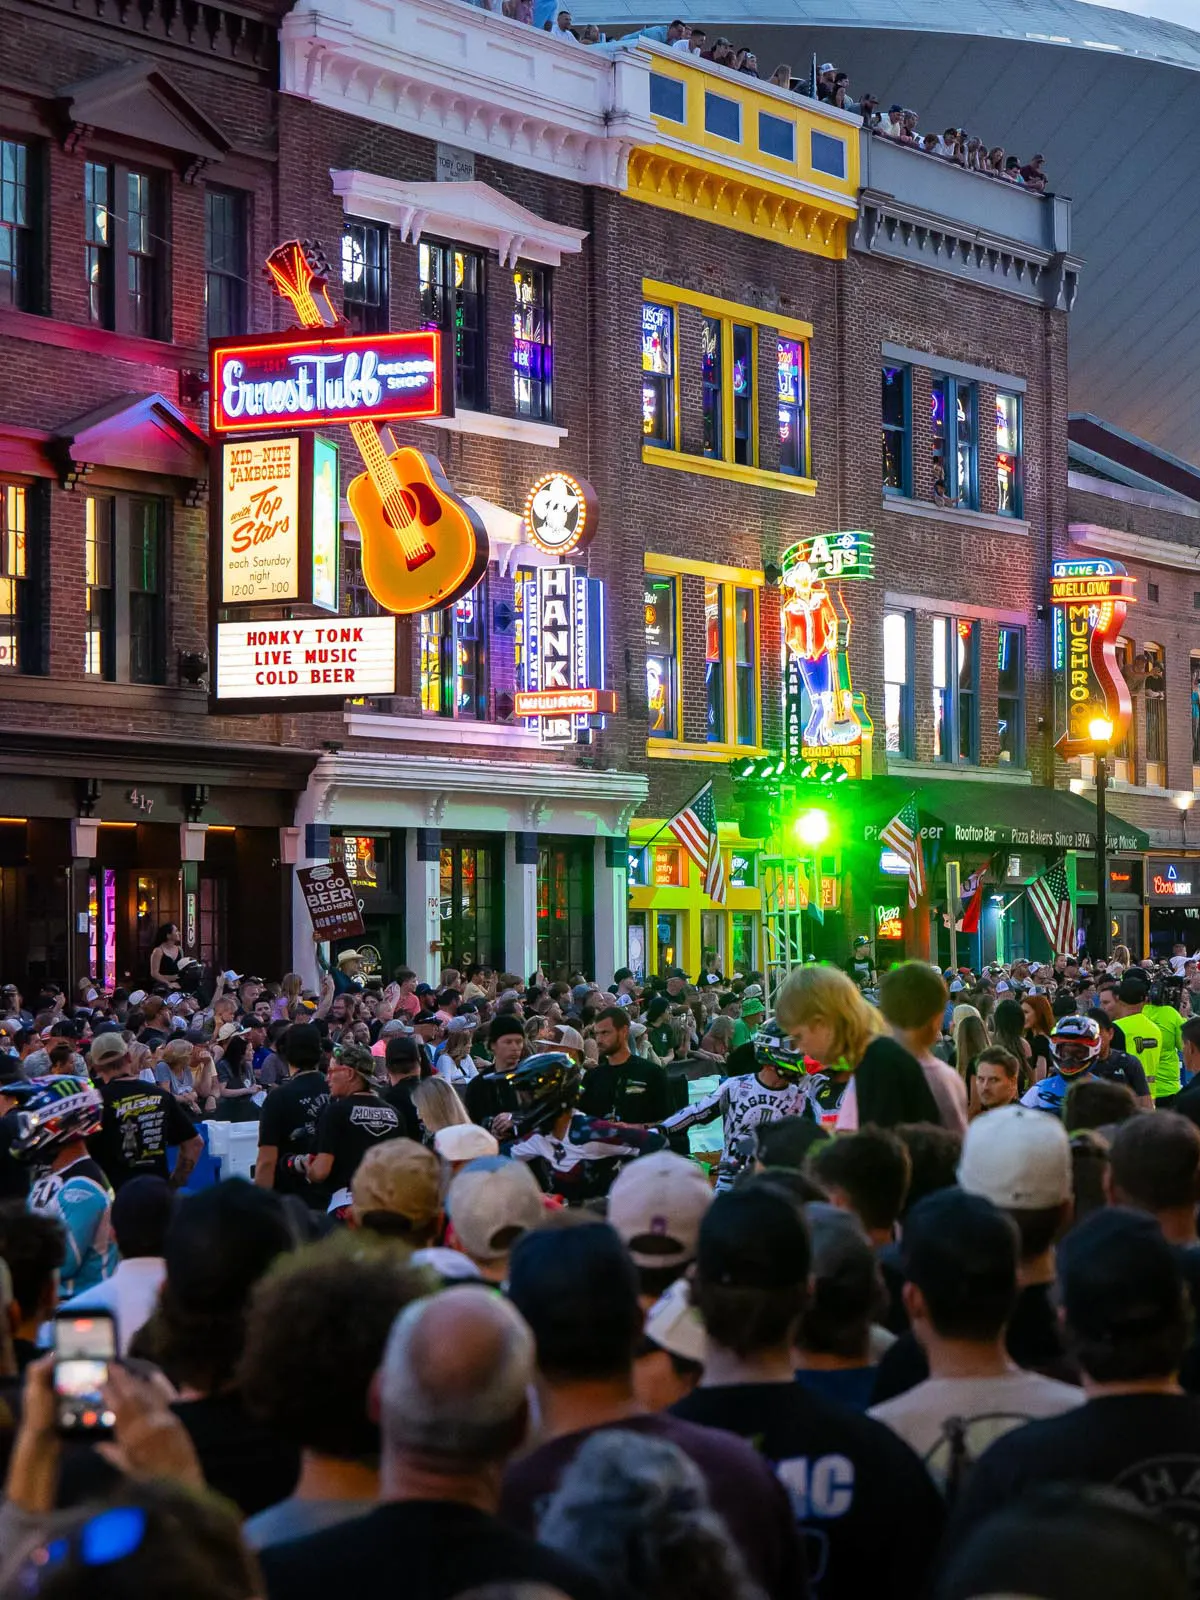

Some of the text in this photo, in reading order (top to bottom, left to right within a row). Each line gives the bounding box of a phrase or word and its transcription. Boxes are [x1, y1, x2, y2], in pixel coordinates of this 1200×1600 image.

[222, 350, 382, 417] Ernest Tubb
[229, 463, 291, 491] JAMBOREE
[250, 485, 282, 521] Top
[231, 515, 289, 553] Stars
[229, 554, 291, 568] each Saturday
[250, 569, 270, 583] night
[1068, 566, 1093, 575] LIVE
[231, 584, 255, 596] 12:00
[272, 582, 289, 593] 1:00
[1053, 581, 1110, 596] MELLOW
[247, 628, 363, 646] HONKY TONK
[543, 570, 568, 687] HANK
[255, 648, 357, 665] LIVE MUSIC
[255, 668, 355, 685] COLD BEER
[789, 653, 798, 694] ALAN
[801, 746, 831, 758] GOOD
[130, 789, 154, 814] 417
[920, 826, 943, 839] eer
[955, 825, 996, 841] Rooftop Bar
[1011, 830, 1090, 848] Pizza Bakers Since 1974
[1119, 836, 1138, 850] Music
[306, 878, 345, 893] TO GO
[307, 888, 353, 907] BEER
[428, 897, 438, 907] FDC
[312, 901, 354, 914] SOLD HERE
[38, 1095, 90, 1119] SCOTT
